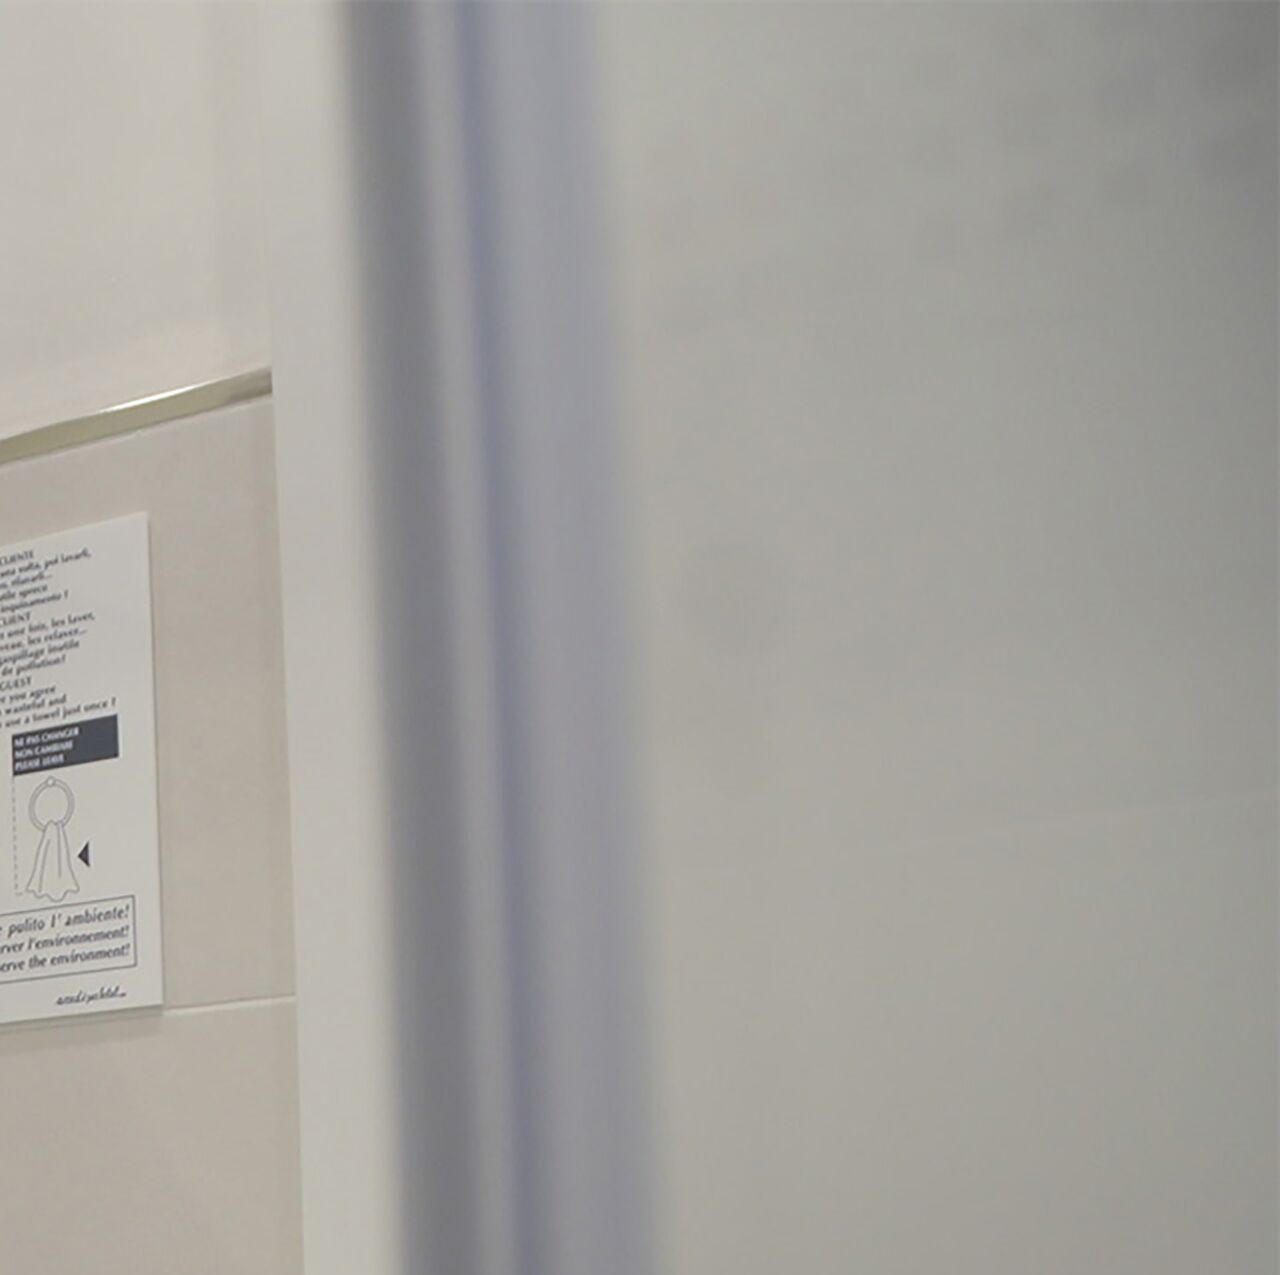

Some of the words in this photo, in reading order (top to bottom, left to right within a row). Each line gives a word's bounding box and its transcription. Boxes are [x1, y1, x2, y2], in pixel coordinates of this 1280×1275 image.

[0, 676, 31, 692] GUEST
[9, 692, 26, 704] you
[30, 686, 56, 699] agree
[48, 694, 66, 707] and
[32, 708, 59, 722] towel
[7, 918, 45, 938] pulito
[65, 904, 129, 926] ambiente!
[29, 955, 47, 968] the
